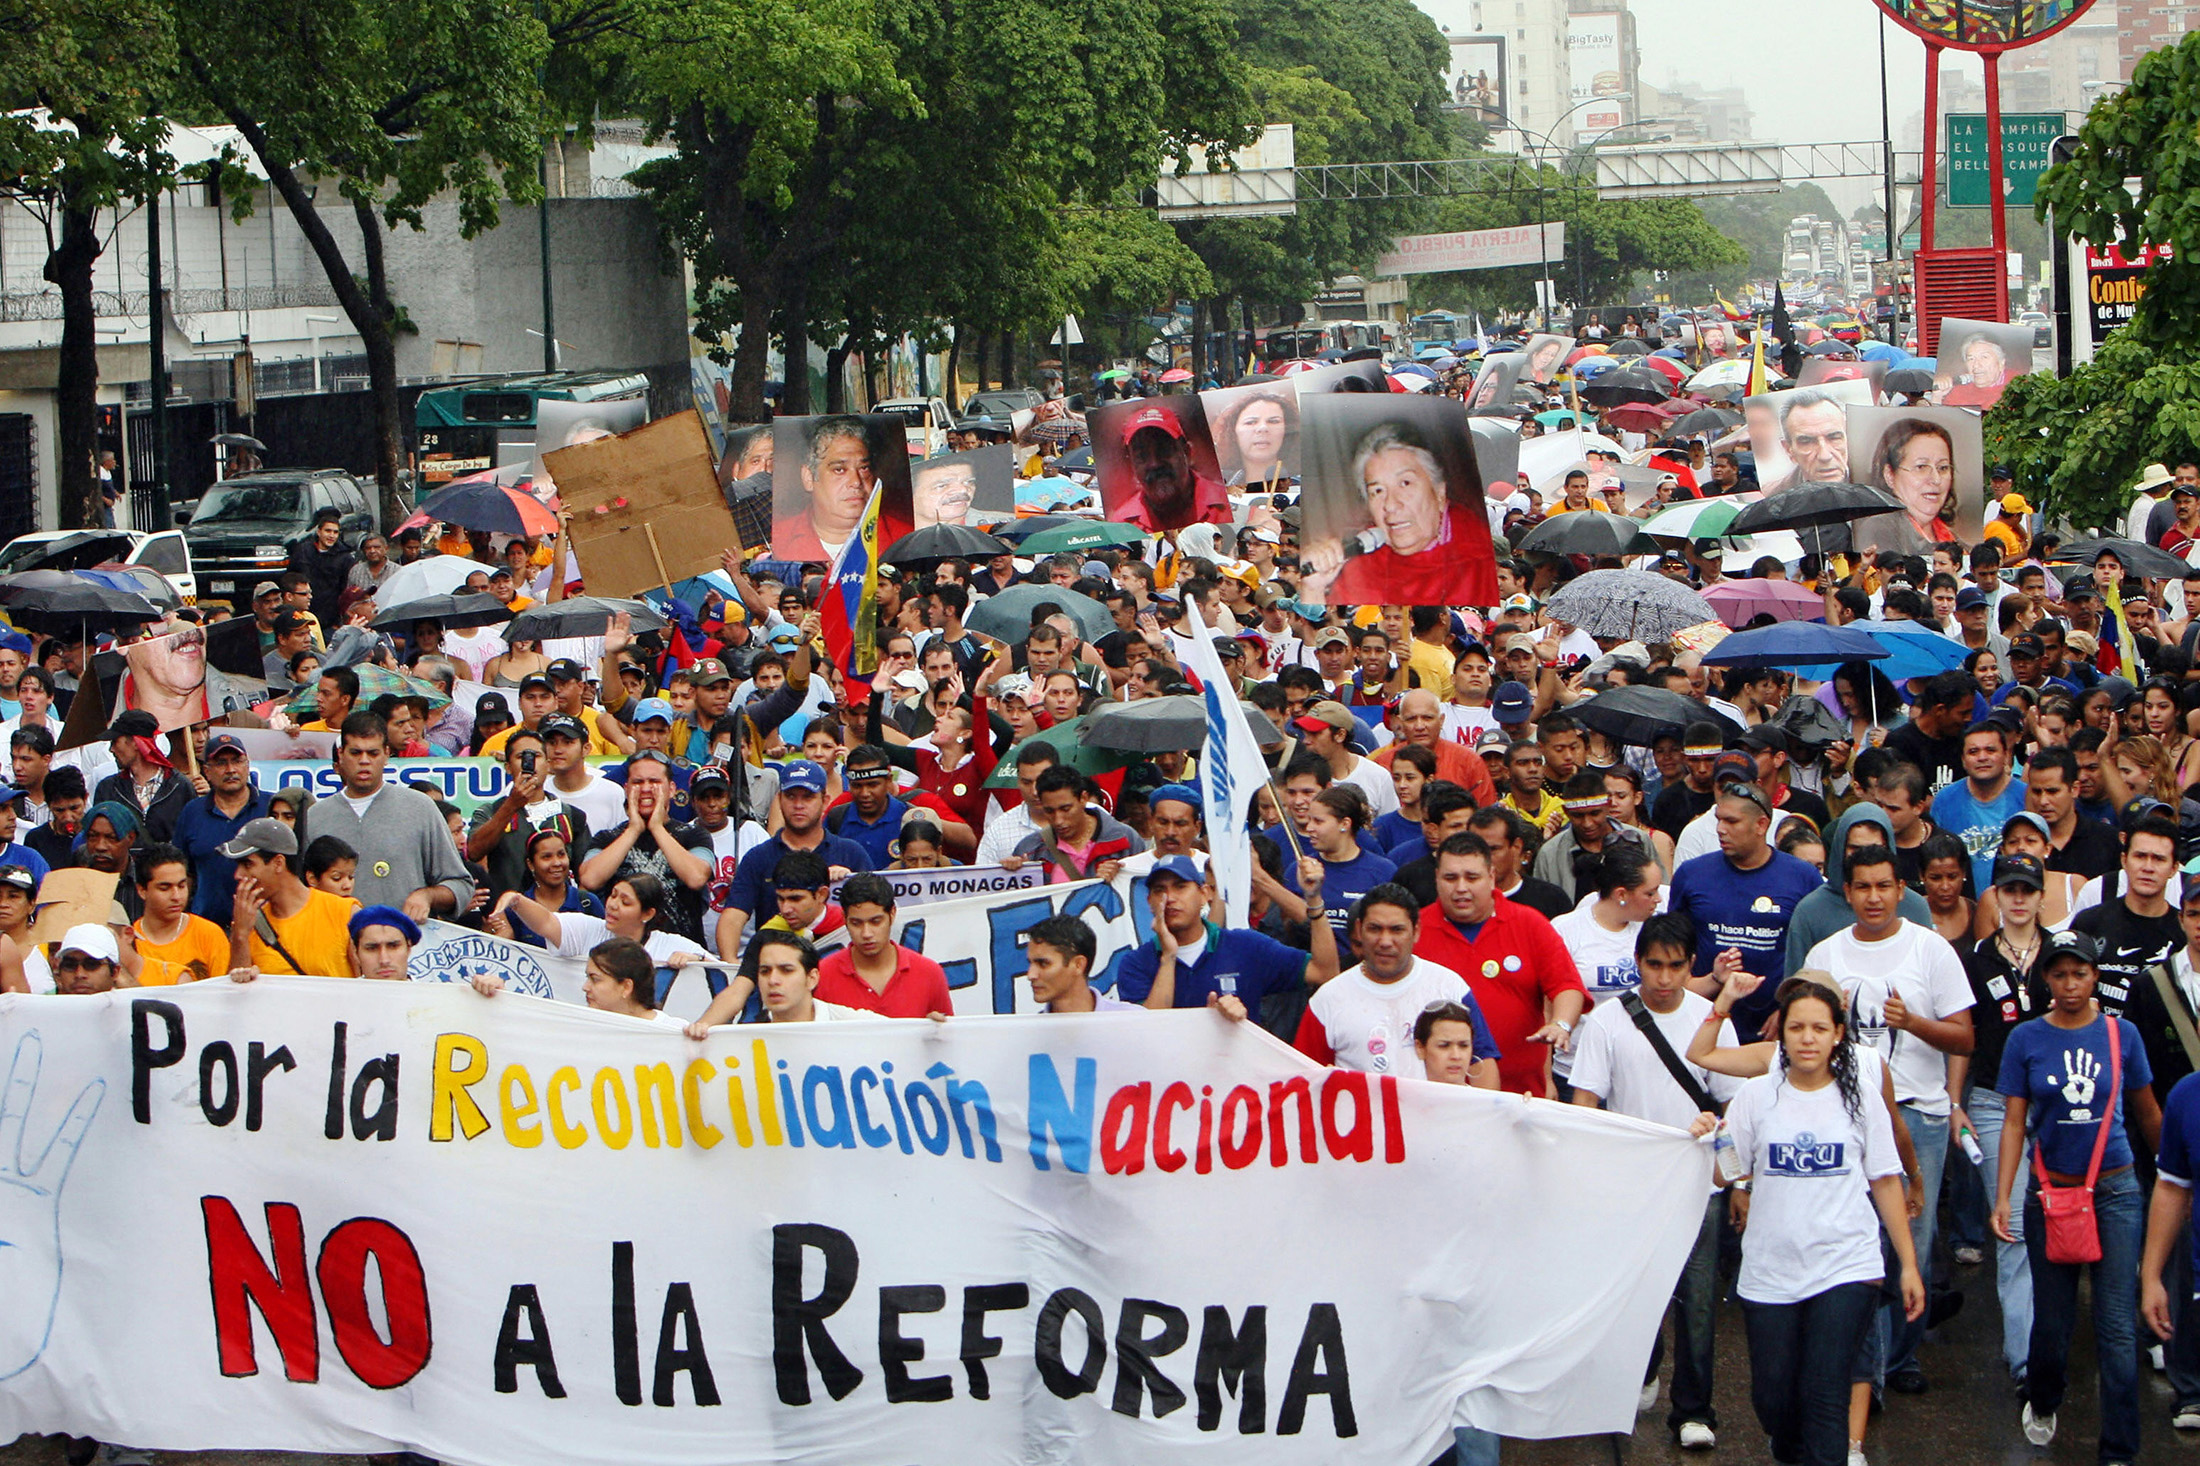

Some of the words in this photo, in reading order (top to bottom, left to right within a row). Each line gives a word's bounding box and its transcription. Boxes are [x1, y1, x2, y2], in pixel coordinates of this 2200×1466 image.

[1569, 34, 1614, 45] BigTasty
[1954, 125, 1973, 135] LA
[1999, 121, 2057, 135] AMPIÑA
[1954, 142, 1972, 153] EL
[1985, 142, 2049, 153] SQUE
[1954, 160, 1990, 171] BELL
[2009, 160, 2048, 171] CAMP
[2097, 305, 2114, 319] de
[929, 875, 1033, 896] MONAGAS
[1721, 924, 1745, 935] hace
[1603, 966, 1642, 986] FC
[131, 998, 297, 1132] Por
[324, 1021, 400, 1142] la
[428, 1032, 1003, 1164] Reconciliación
[1028, 1053, 1406, 1176] Nacional
[200, 1194, 433, 1390] NO
[494, 1283, 568, 1400] A
[772, 1222, 1359, 1440] REFORMA
